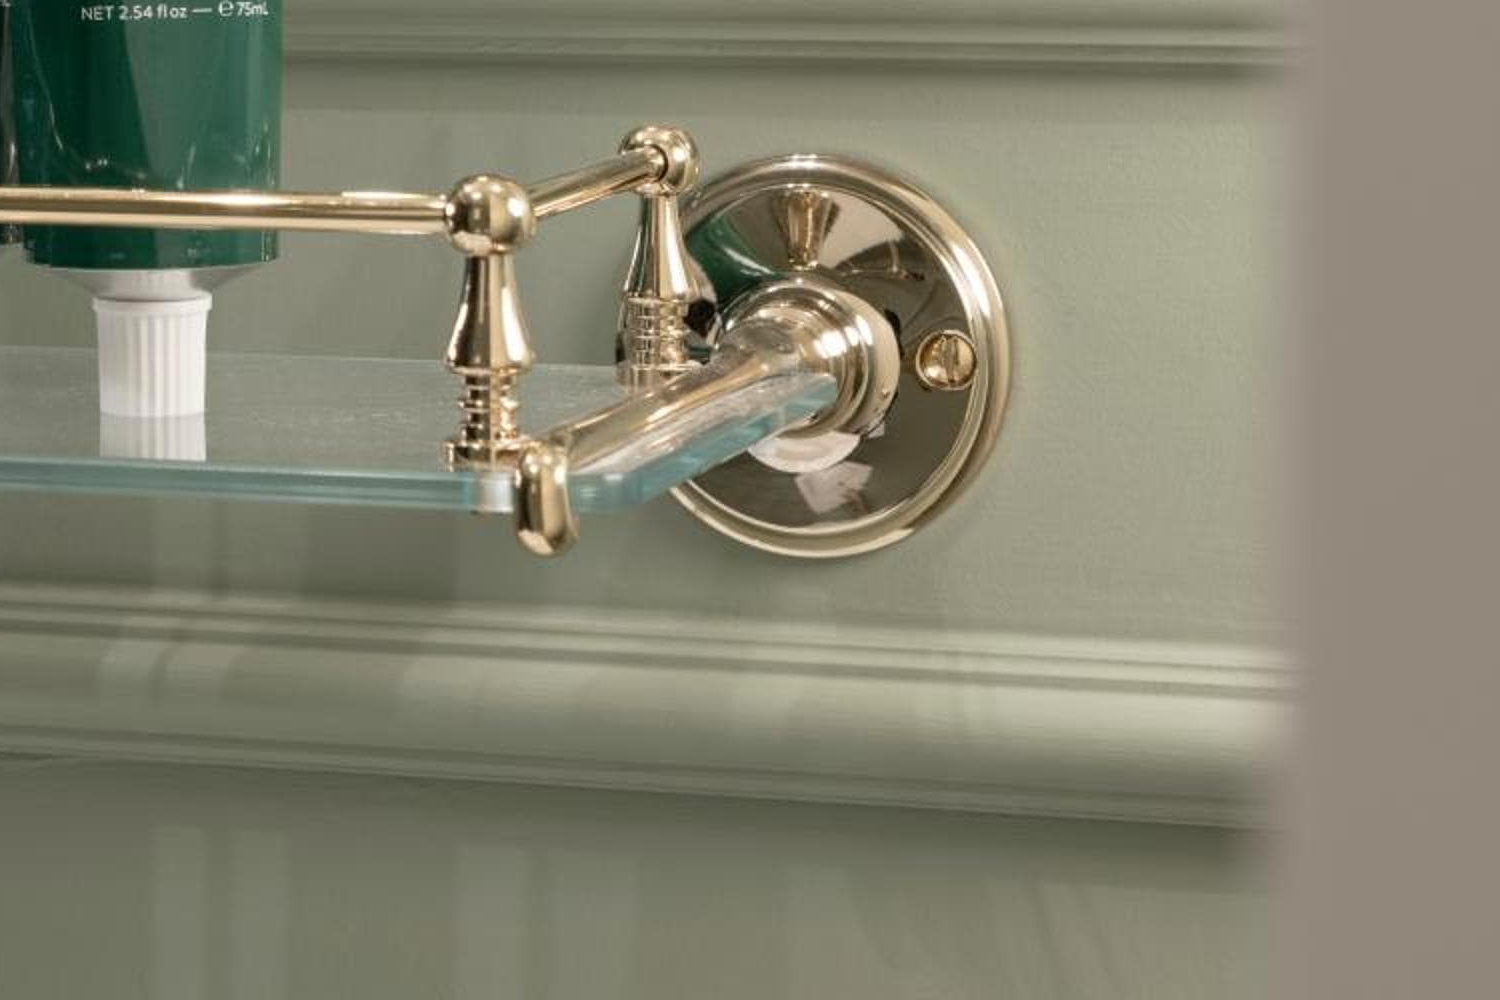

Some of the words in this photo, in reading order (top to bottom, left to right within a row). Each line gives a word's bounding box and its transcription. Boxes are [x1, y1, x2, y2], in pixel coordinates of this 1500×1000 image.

[81, 5, 114, 21] NET
[119, 4, 153, 20] 2.54
[169, 6, 187, 18] oz
